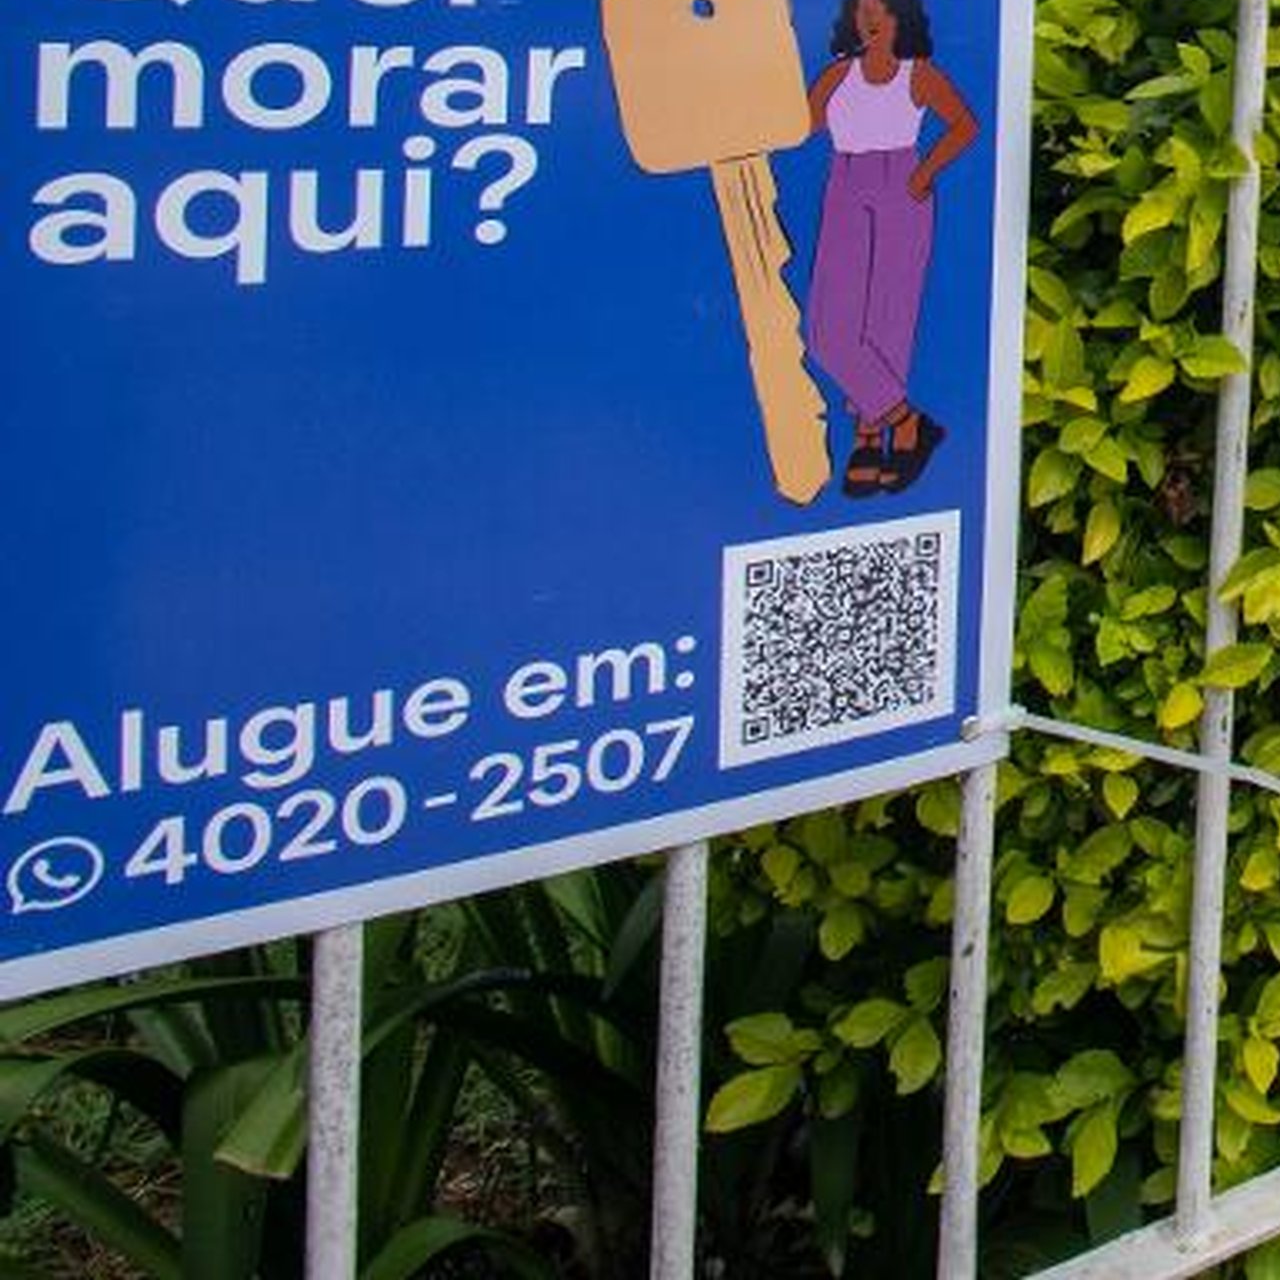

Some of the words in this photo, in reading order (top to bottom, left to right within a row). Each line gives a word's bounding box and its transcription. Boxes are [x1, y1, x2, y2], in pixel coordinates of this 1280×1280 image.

[38, 40, 585, 129] morar
[29, 134, 537, 284] aqui?
[3, 679, 470, 814] Alugue
[503, 636, 696, 718] em:
